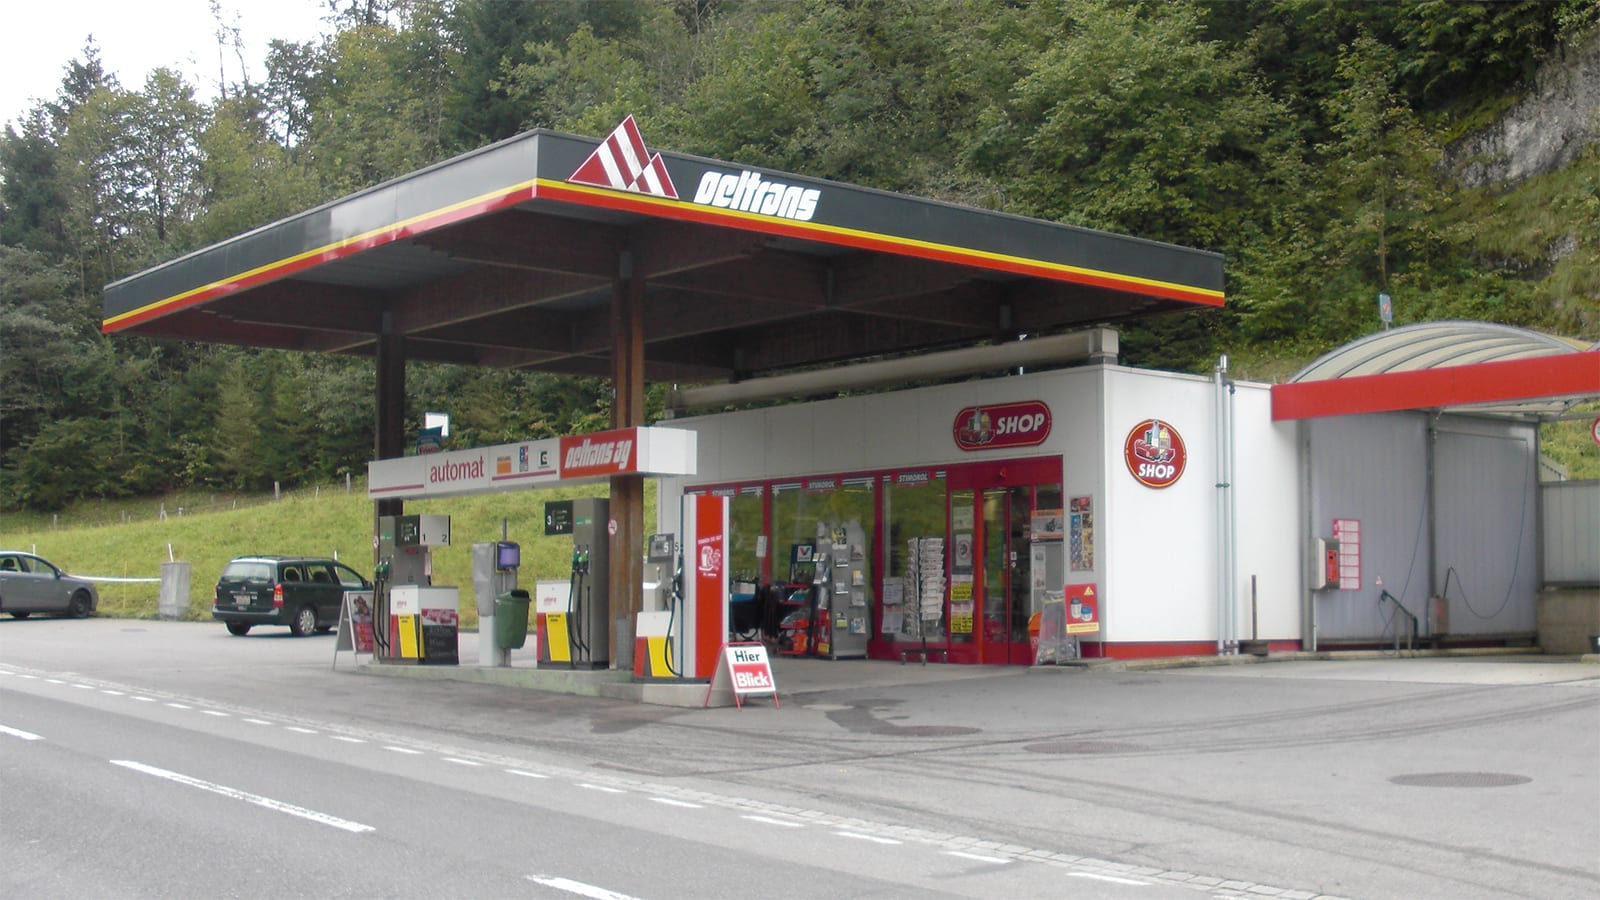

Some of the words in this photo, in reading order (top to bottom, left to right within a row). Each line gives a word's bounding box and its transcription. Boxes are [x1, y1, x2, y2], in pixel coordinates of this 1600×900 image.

[996, 413, 1045, 435] SHOP
[430, 455, 484, 483] automat
[1138, 463, 1175, 479] SHOP
[546, 515, 552, 526] 3
[441, 534, 448, 543] 2
[663, 542, 669, 553] 5
[674, 541, 680, 552] 5
[734, 650, 760, 662] Hier
[736, 671, 770, 687] Blick
